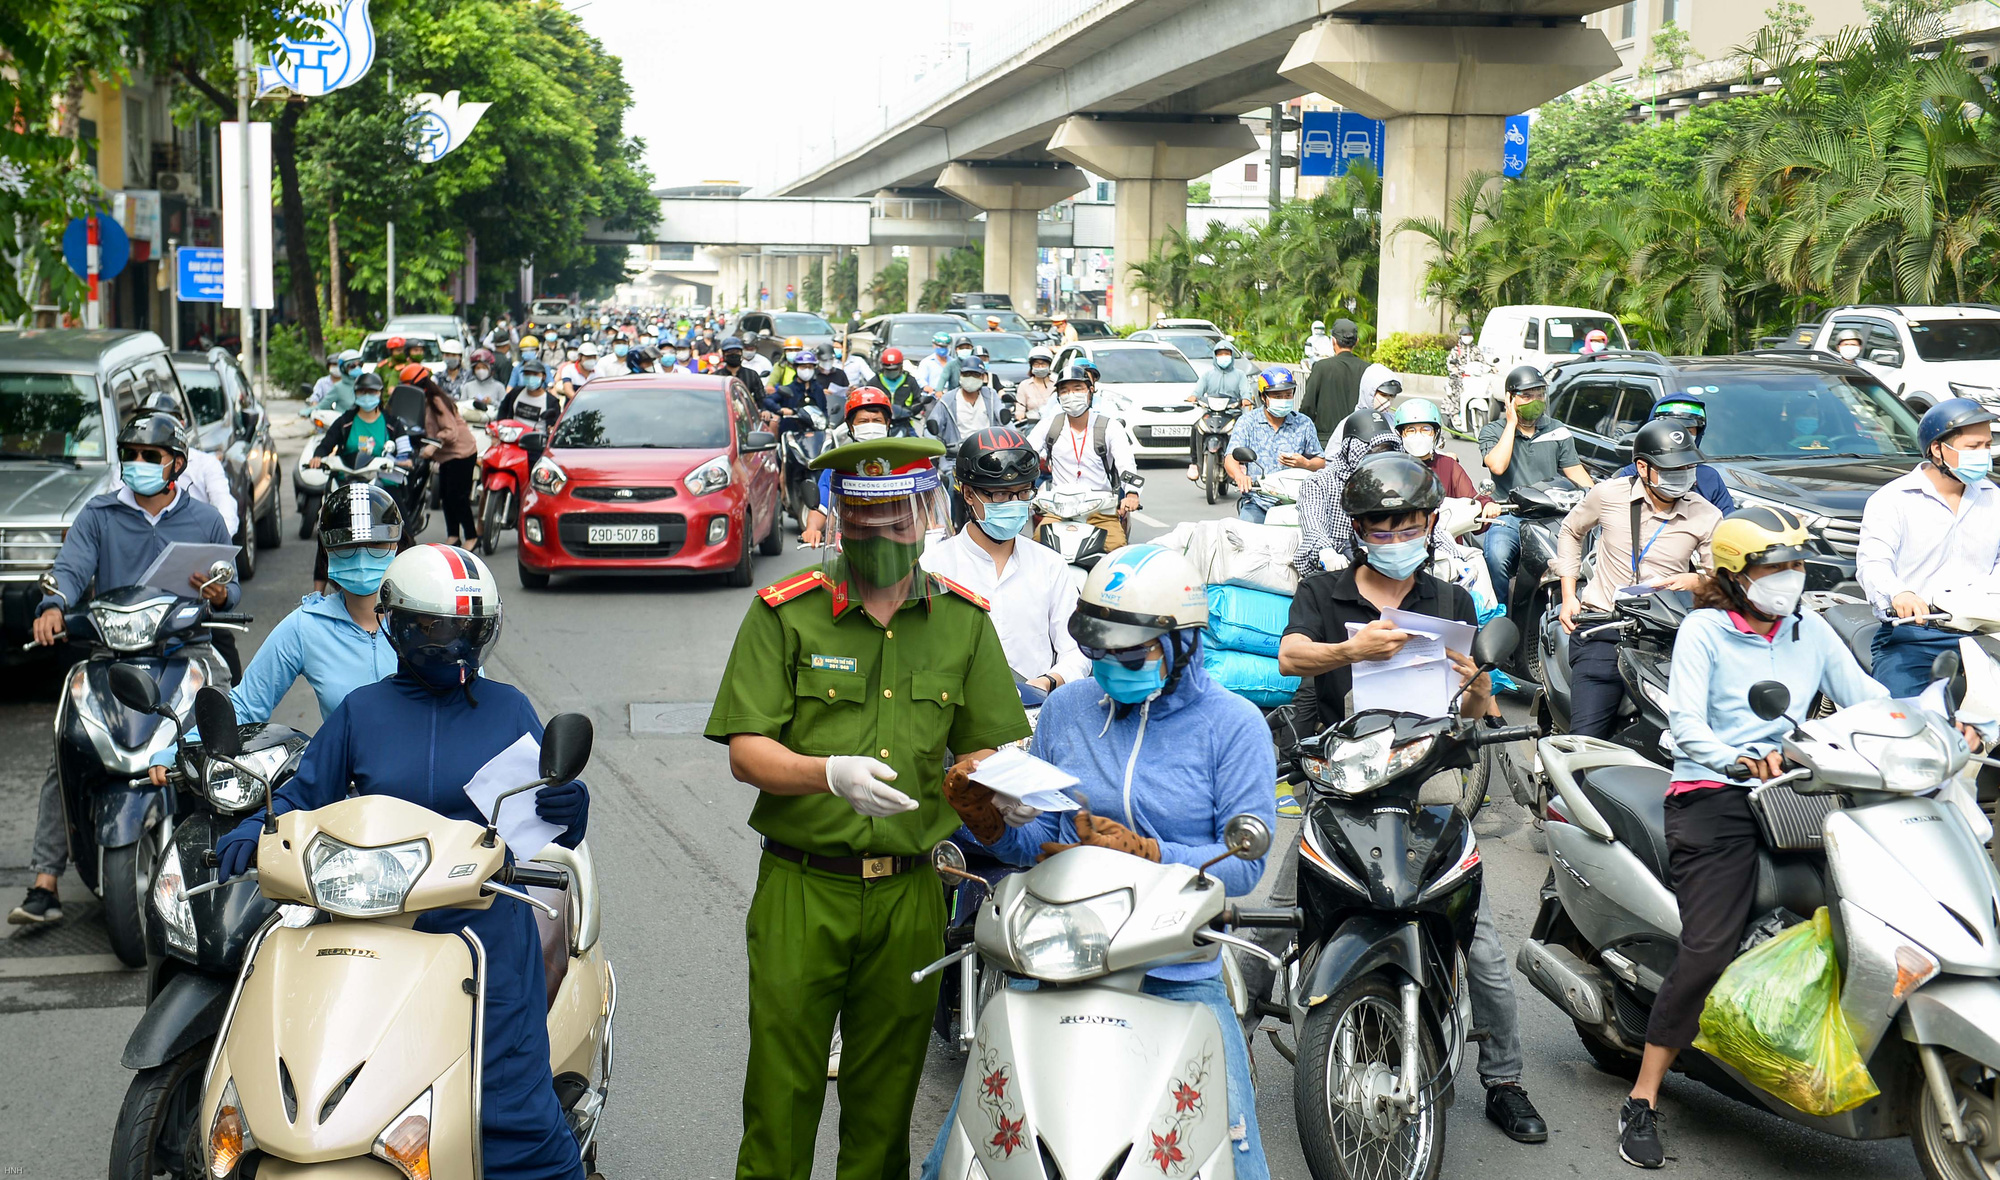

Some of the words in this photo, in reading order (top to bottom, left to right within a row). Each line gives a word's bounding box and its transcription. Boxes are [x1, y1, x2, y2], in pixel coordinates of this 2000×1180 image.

[1101, 592, 1121, 601] VNPT
[1373, 807, 1409, 815] HONDA
[315, 947, 381, 960] HONDA
[1059, 1015, 1133, 1029] HONDA
